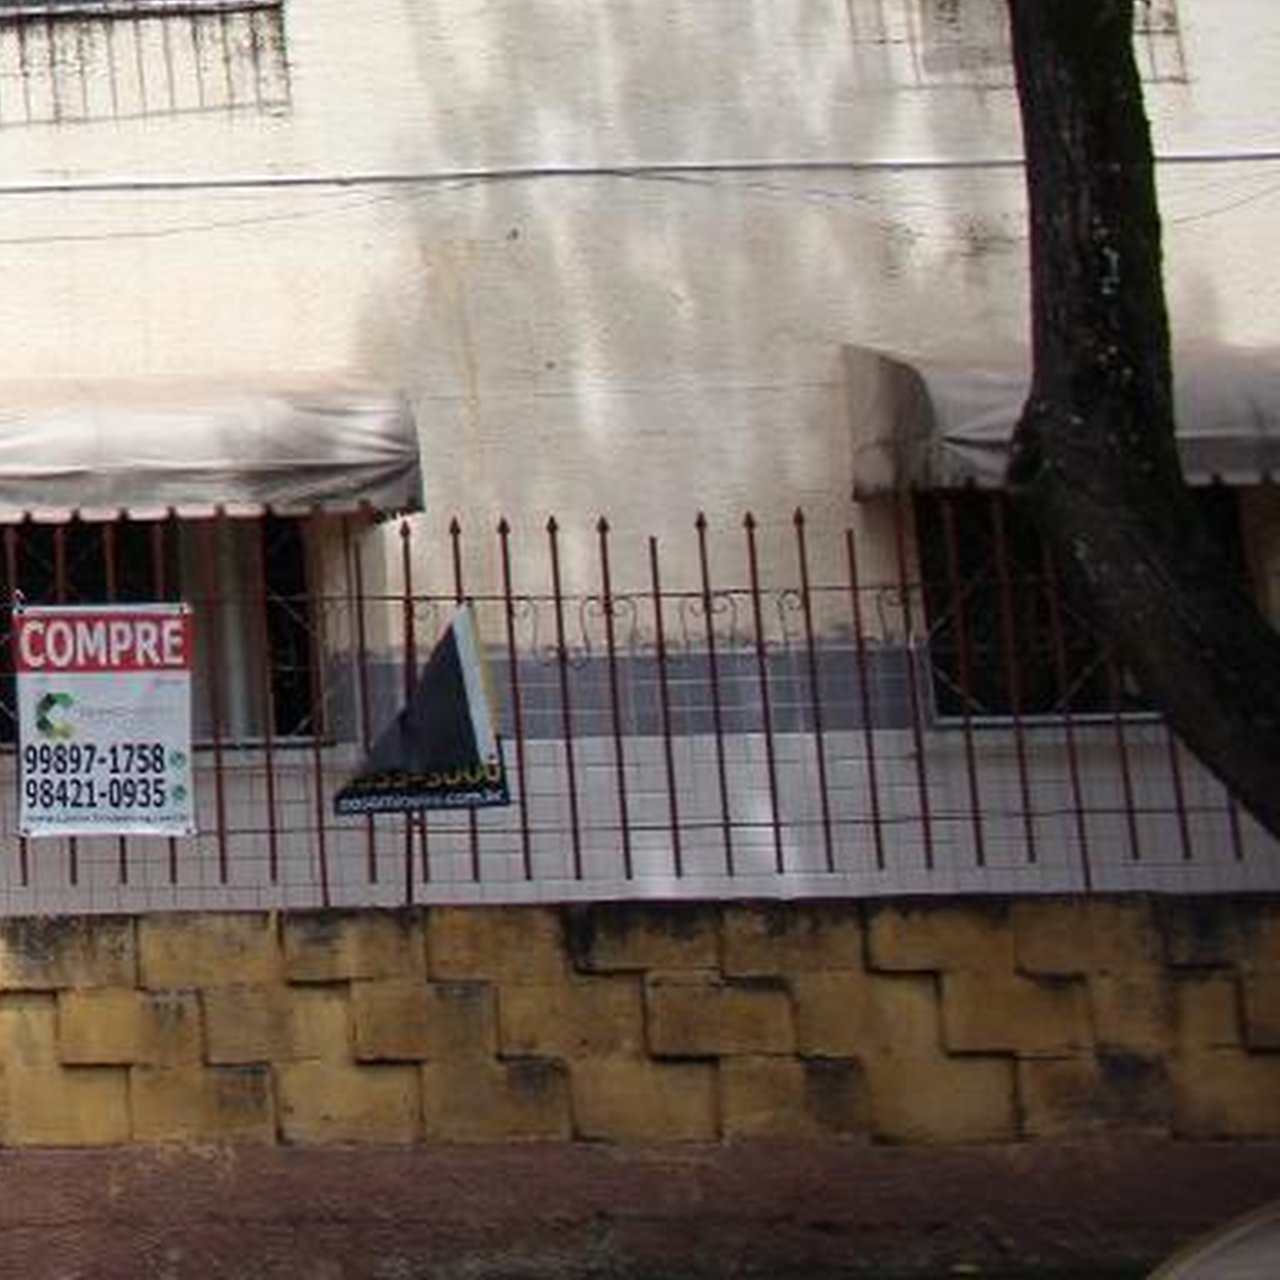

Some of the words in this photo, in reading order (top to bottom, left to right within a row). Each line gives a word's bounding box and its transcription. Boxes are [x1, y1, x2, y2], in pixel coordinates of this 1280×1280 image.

[20, 620, 184, 667] COMPRE
[25, 744, 166, 774] 99897-1758
[25, 779, 167, 809] 98421-0935
